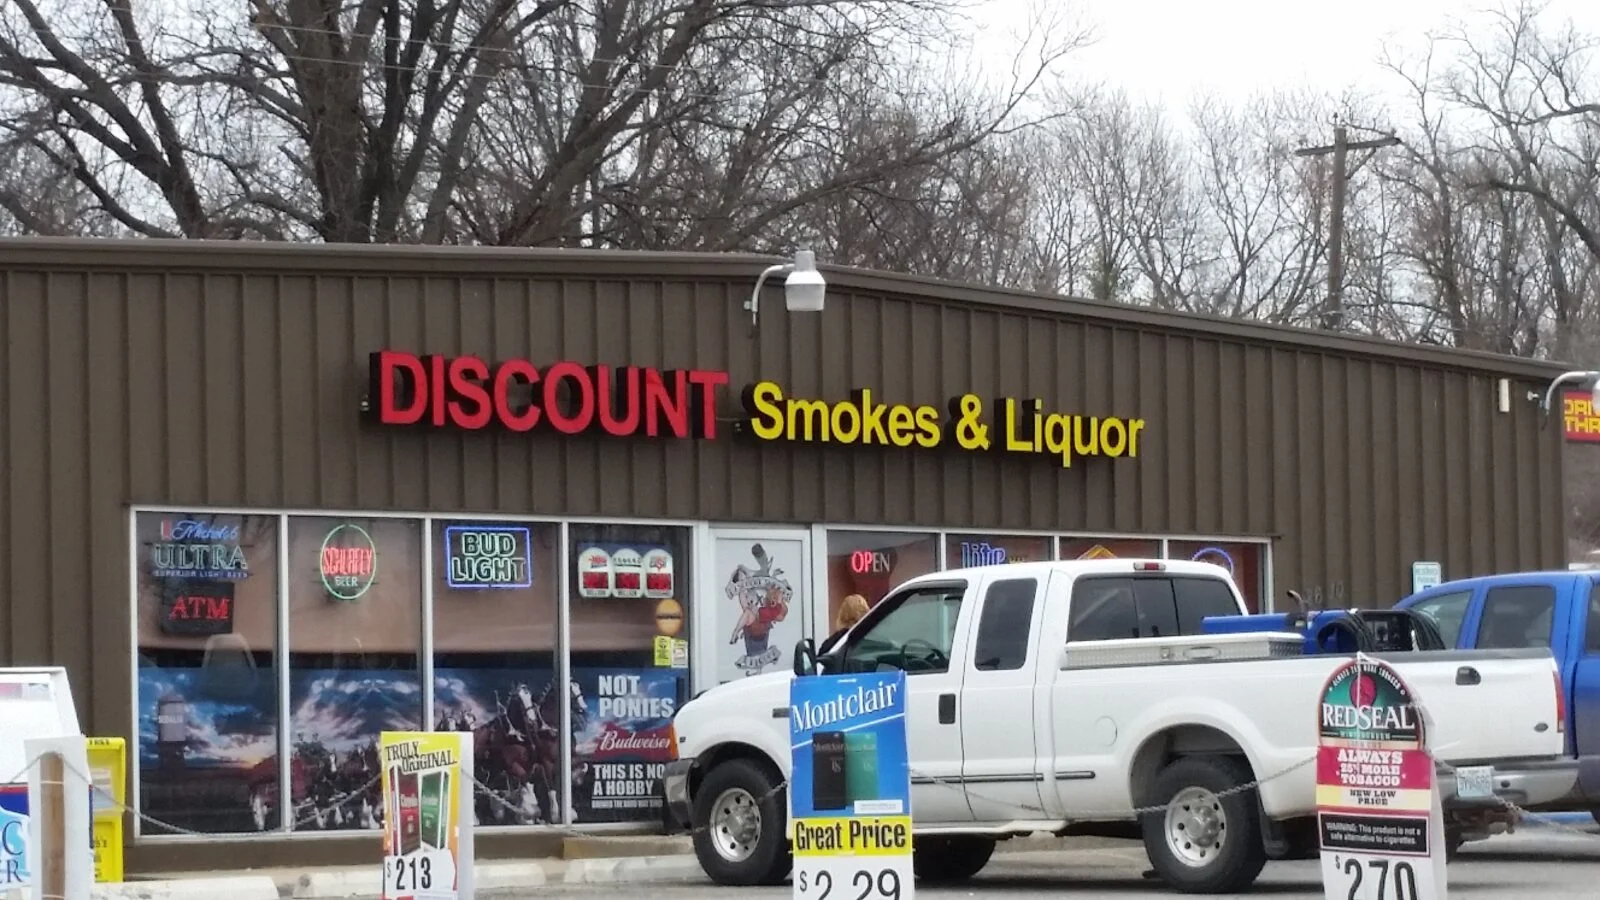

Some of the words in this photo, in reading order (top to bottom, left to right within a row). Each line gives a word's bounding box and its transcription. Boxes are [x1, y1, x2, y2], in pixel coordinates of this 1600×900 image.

[379, 350, 729, 440] DISCOUNT
[751, 382, 941, 448] Smokes
[956, 394, 990, 450] &
[1006, 398, 1145, 468] Liquor
[462, 532, 517, 557] BUD
[154, 543, 249, 570] ULTRA
[851, 551, 890, 574] OPEN
[451, 557, 527, 582] LIGHT
[169, 596, 232, 620] ATM
[598, 675, 641, 696] NOT
[599, 697, 675, 718] PONIES
[792, 681, 898, 734] Montclair
[385, 740, 420, 762] TRULY
[600, 729, 671, 751] Budweiser
[1337, 749, 1403, 765] ALWAYS
[593, 763, 626, 780] THIS
[629, 763, 644, 779] IS
[1341, 773, 1401, 787] TOBACCO
[1361, 764, 1401, 776] MORE
[593, 780, 603, 796] A
[606, 780, 654, 796] HOBBY
[1350, 789, 1371, 797] NEW
[1374, 790, 1396, 798] LOW
[1358, 797, 1388, 806] PRICE
[796, 821, 843, 851] Great
[850, 819, 907, 849] Price
